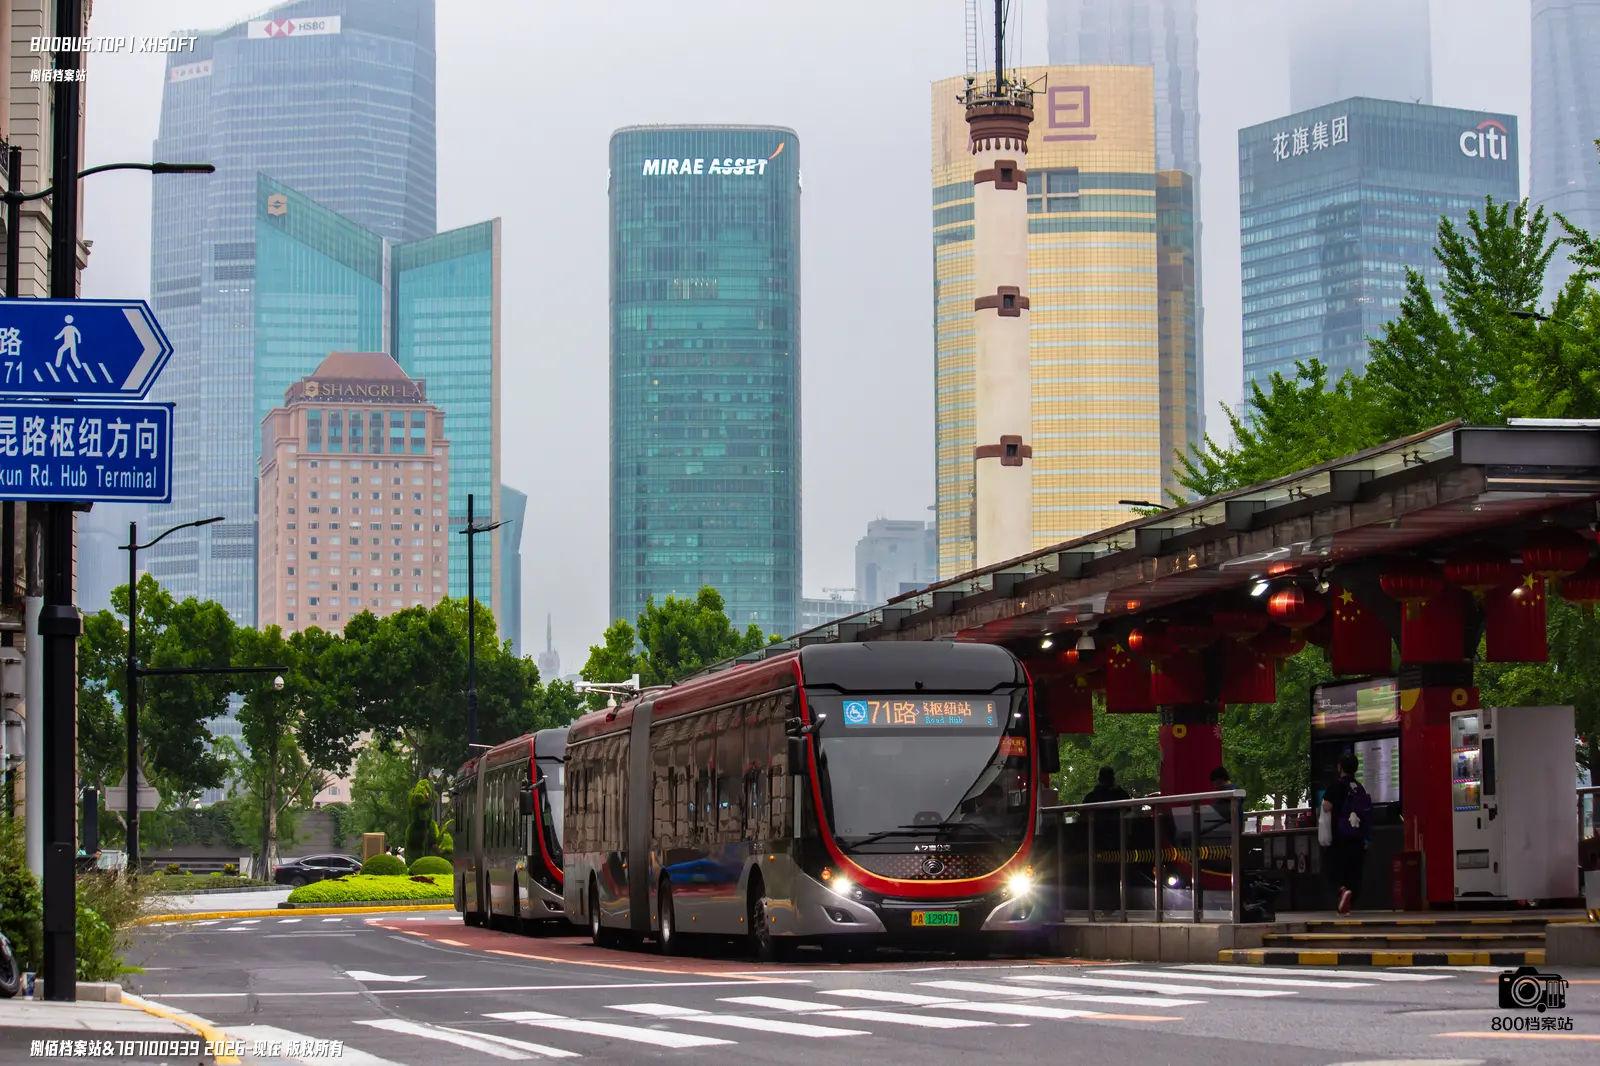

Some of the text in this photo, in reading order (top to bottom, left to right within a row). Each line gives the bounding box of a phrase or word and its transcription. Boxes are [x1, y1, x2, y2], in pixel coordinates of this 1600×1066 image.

[299, 21, 325, 31] HSBC
[1272, 115, 1348, 162] 花旗集团
[1460, 126, 1507, 160] citi
[642, 158, 768, 175] MIRAE ASSET
[0, 326, 22, 356] 路
[4, 361, 23, 384] 71
[321, 383, 423, 397] SHANGRI-LA
[0, 415, 158, 459] 昆路枢纽方向
[30, 464, 53, 486] Rd.
[61, 464, 87, 487] Hub
[96, 465, 157, 489] Terminal
[867, 701, 917, 724] 71路
